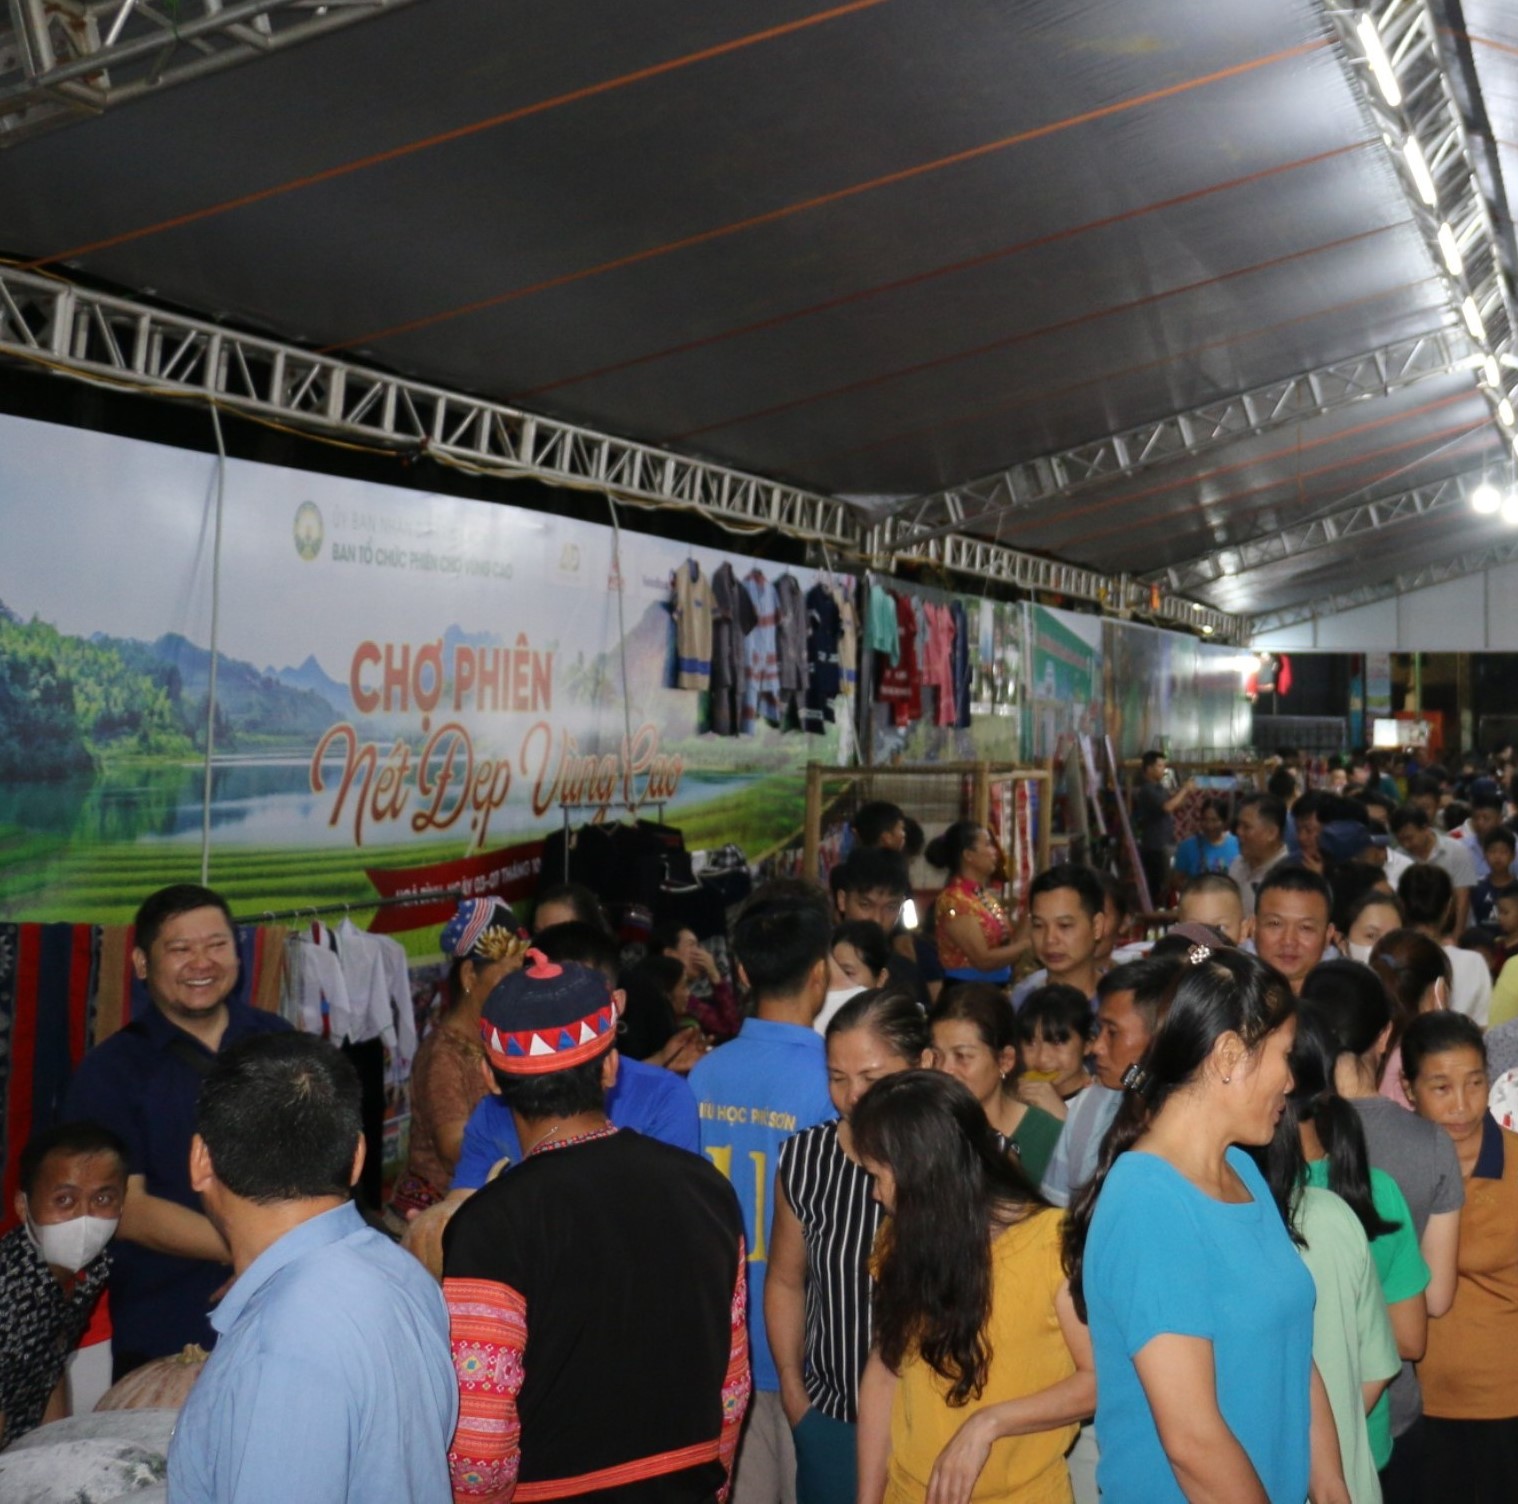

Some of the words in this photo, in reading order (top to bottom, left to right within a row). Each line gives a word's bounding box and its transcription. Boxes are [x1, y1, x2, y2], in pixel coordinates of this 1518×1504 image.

[332, 541, 356, 564] BAN
[358, 536, 373, 566] TỔ
[375, 544, 407, 569] CHỨC
[350, 637, 444, 733] CHỢ
[454, 631, 553, 712] PHIÊN
[310, 721, 411, 848] Nét
[411, 722, 512, 848] Đẹp
[519, 720, 617, 824] Vùng
[621, 722, 684, 814] Cao
[717, 1103, 748, 1127] HỌC
